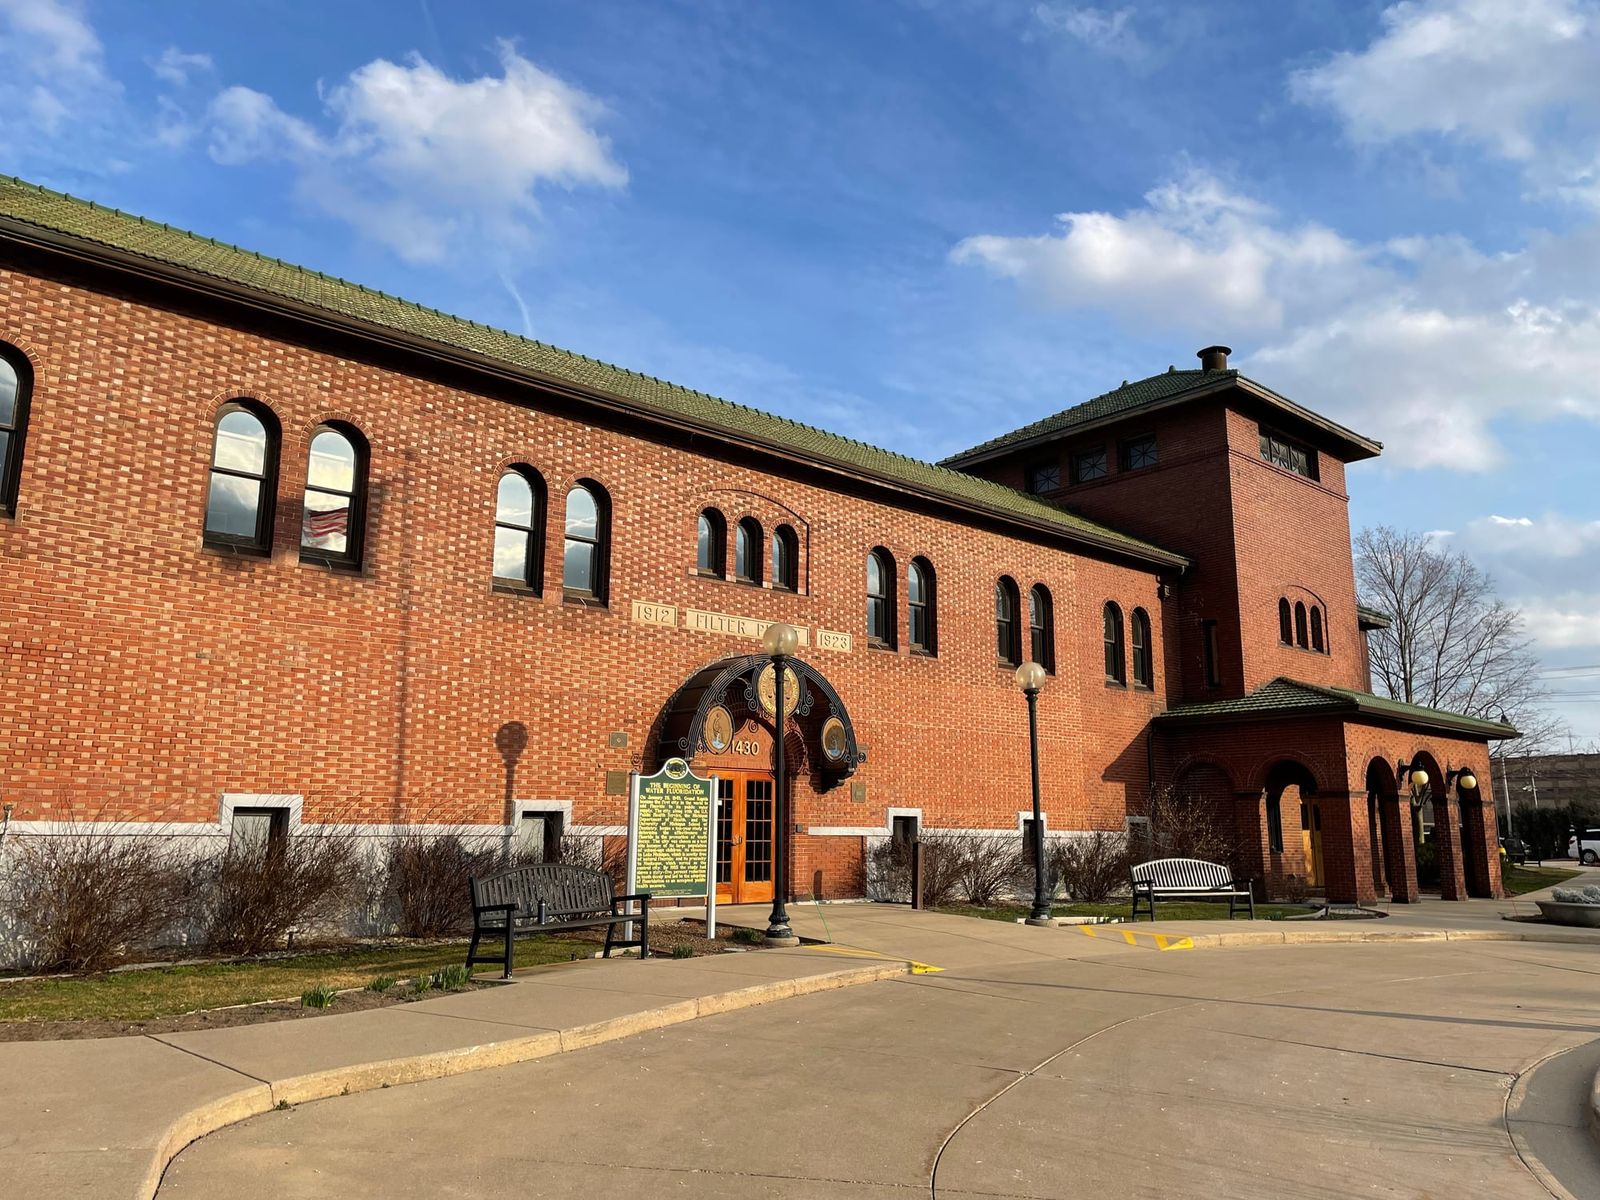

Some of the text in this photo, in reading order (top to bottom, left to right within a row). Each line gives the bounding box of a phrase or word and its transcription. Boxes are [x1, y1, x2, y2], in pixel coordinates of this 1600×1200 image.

[637, 605, 671, 623] 1912
[696, 613, 745, 635] FILTER
[820, 632, 847, 649] 1923
[731, 740, 760, 756] 1430
